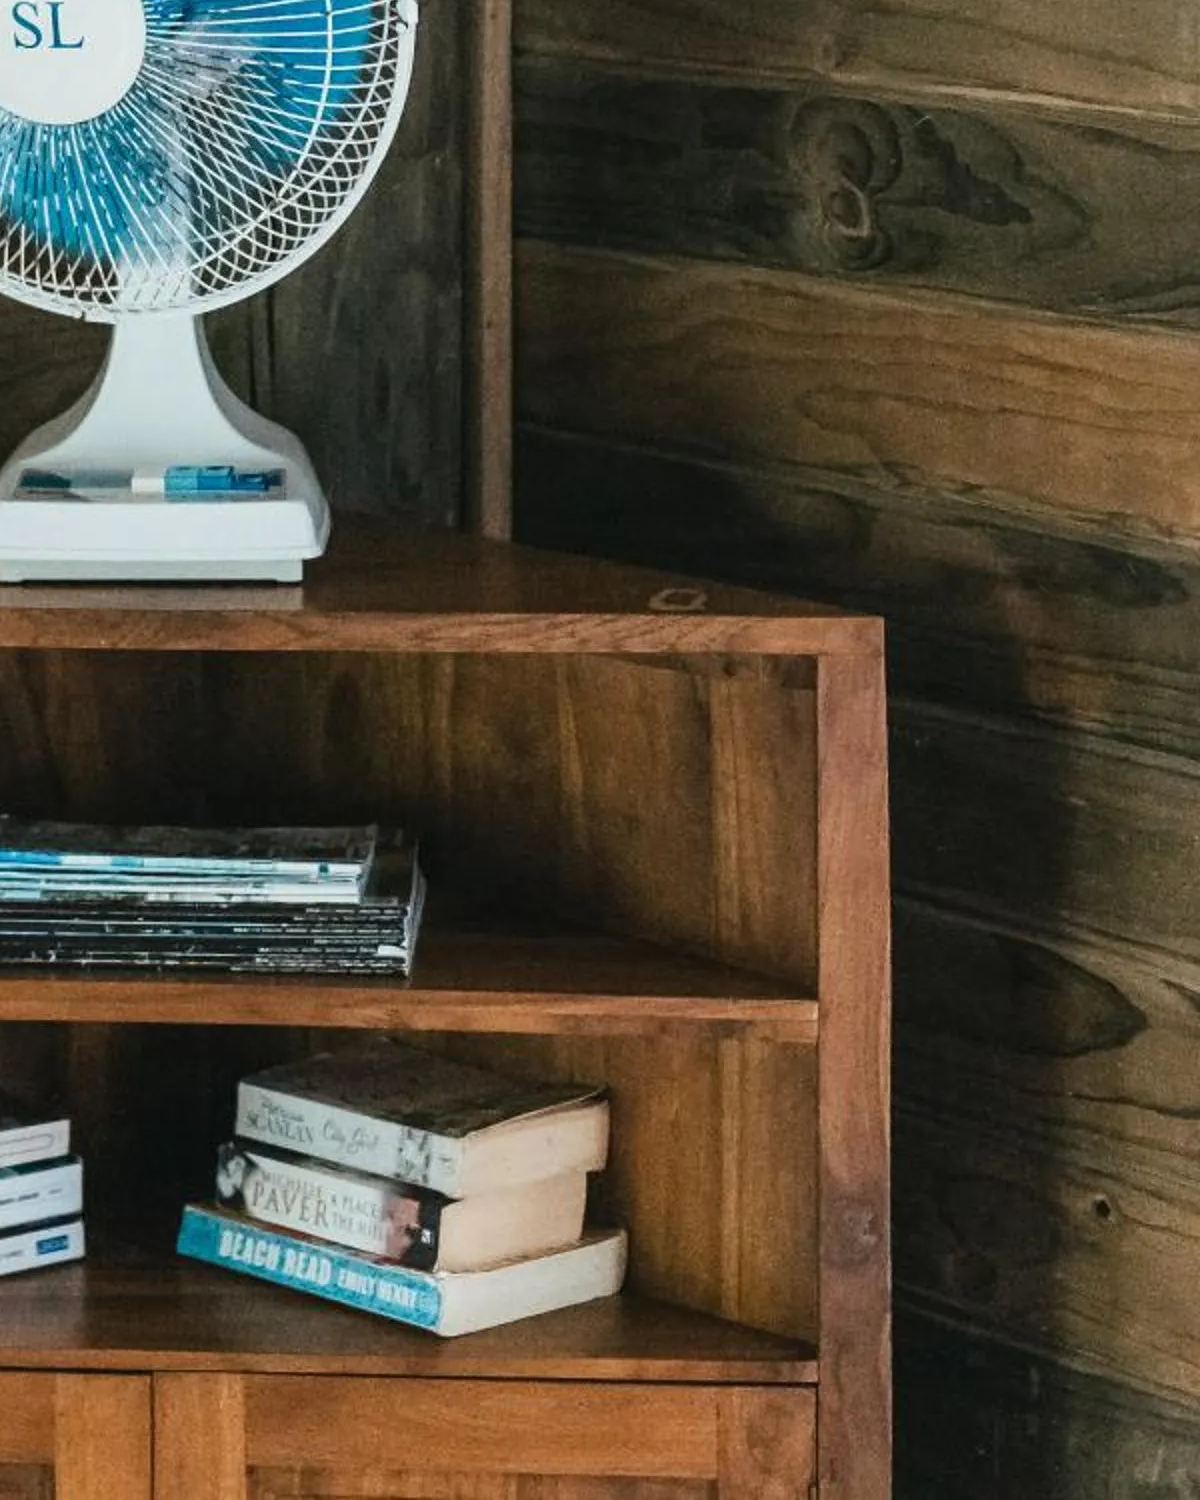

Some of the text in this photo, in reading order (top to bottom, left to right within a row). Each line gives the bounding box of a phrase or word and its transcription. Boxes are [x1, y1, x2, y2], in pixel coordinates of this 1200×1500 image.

[12, 1, 84, 49] SL
[252, 1181, 329, 1228] PAVER
[220, 1229, 282, 1271] BEACH
[283, 1250, 333, 1288] READ
